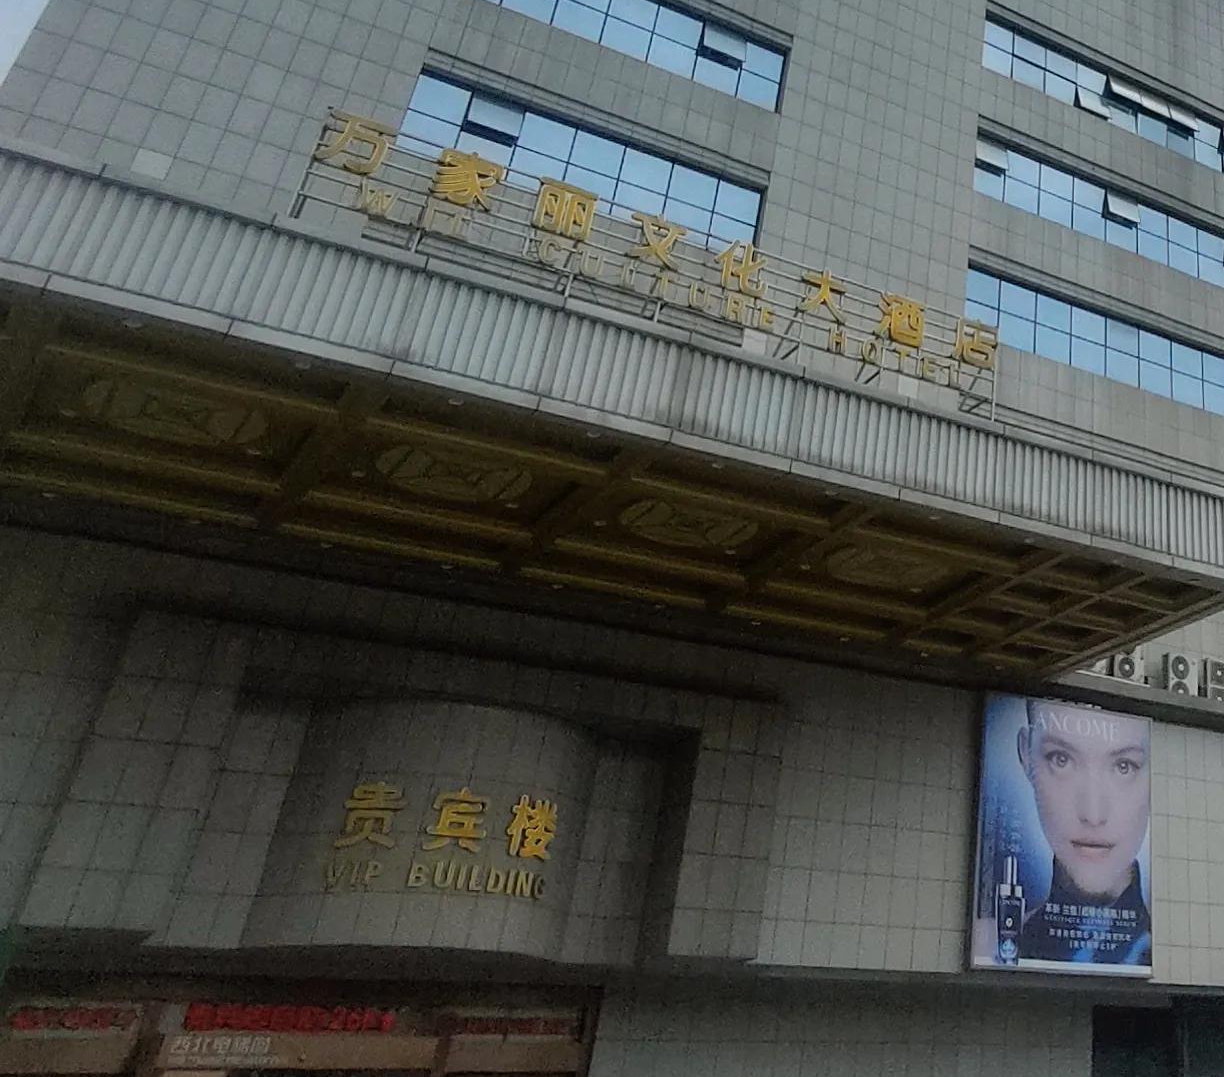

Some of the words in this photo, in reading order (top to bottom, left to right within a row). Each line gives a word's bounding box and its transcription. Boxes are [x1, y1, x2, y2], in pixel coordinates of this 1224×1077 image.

[314, 109, 998, 369] 万家丽文化大酒店
[828, 325, 959, 387] HOTEL
[332, 780, 558, 860] 贵宾楼
[326, 860, 382, 888] VIP
